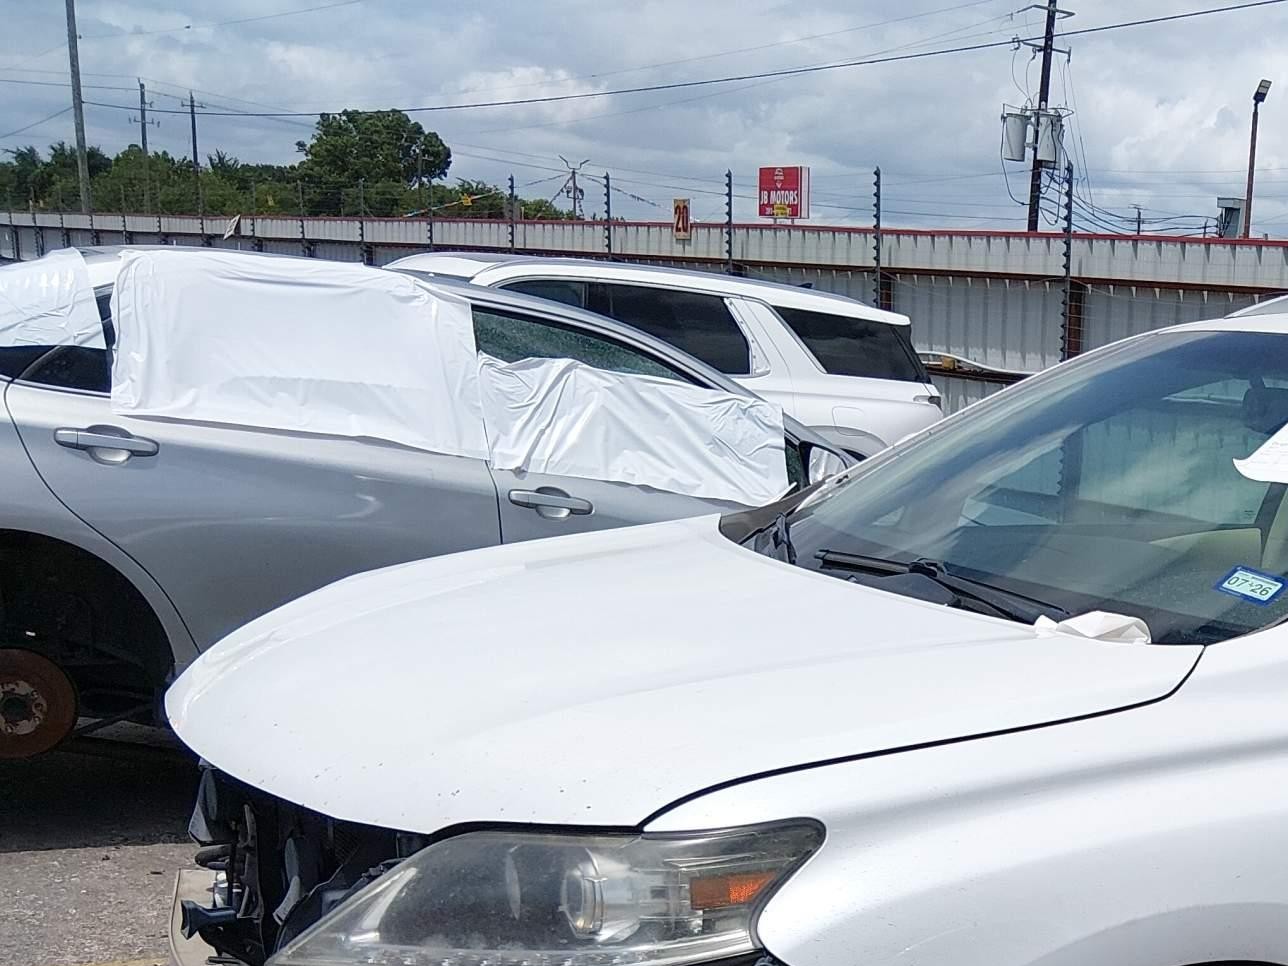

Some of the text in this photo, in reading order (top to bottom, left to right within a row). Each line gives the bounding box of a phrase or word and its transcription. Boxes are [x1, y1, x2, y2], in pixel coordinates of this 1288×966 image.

[760, 190, 798, 205] JB MOTORS
[674, 204, 689, 233] 20
[1226, 576, 1249, 588] 07
[1249, 583, 1273, 597] 26
